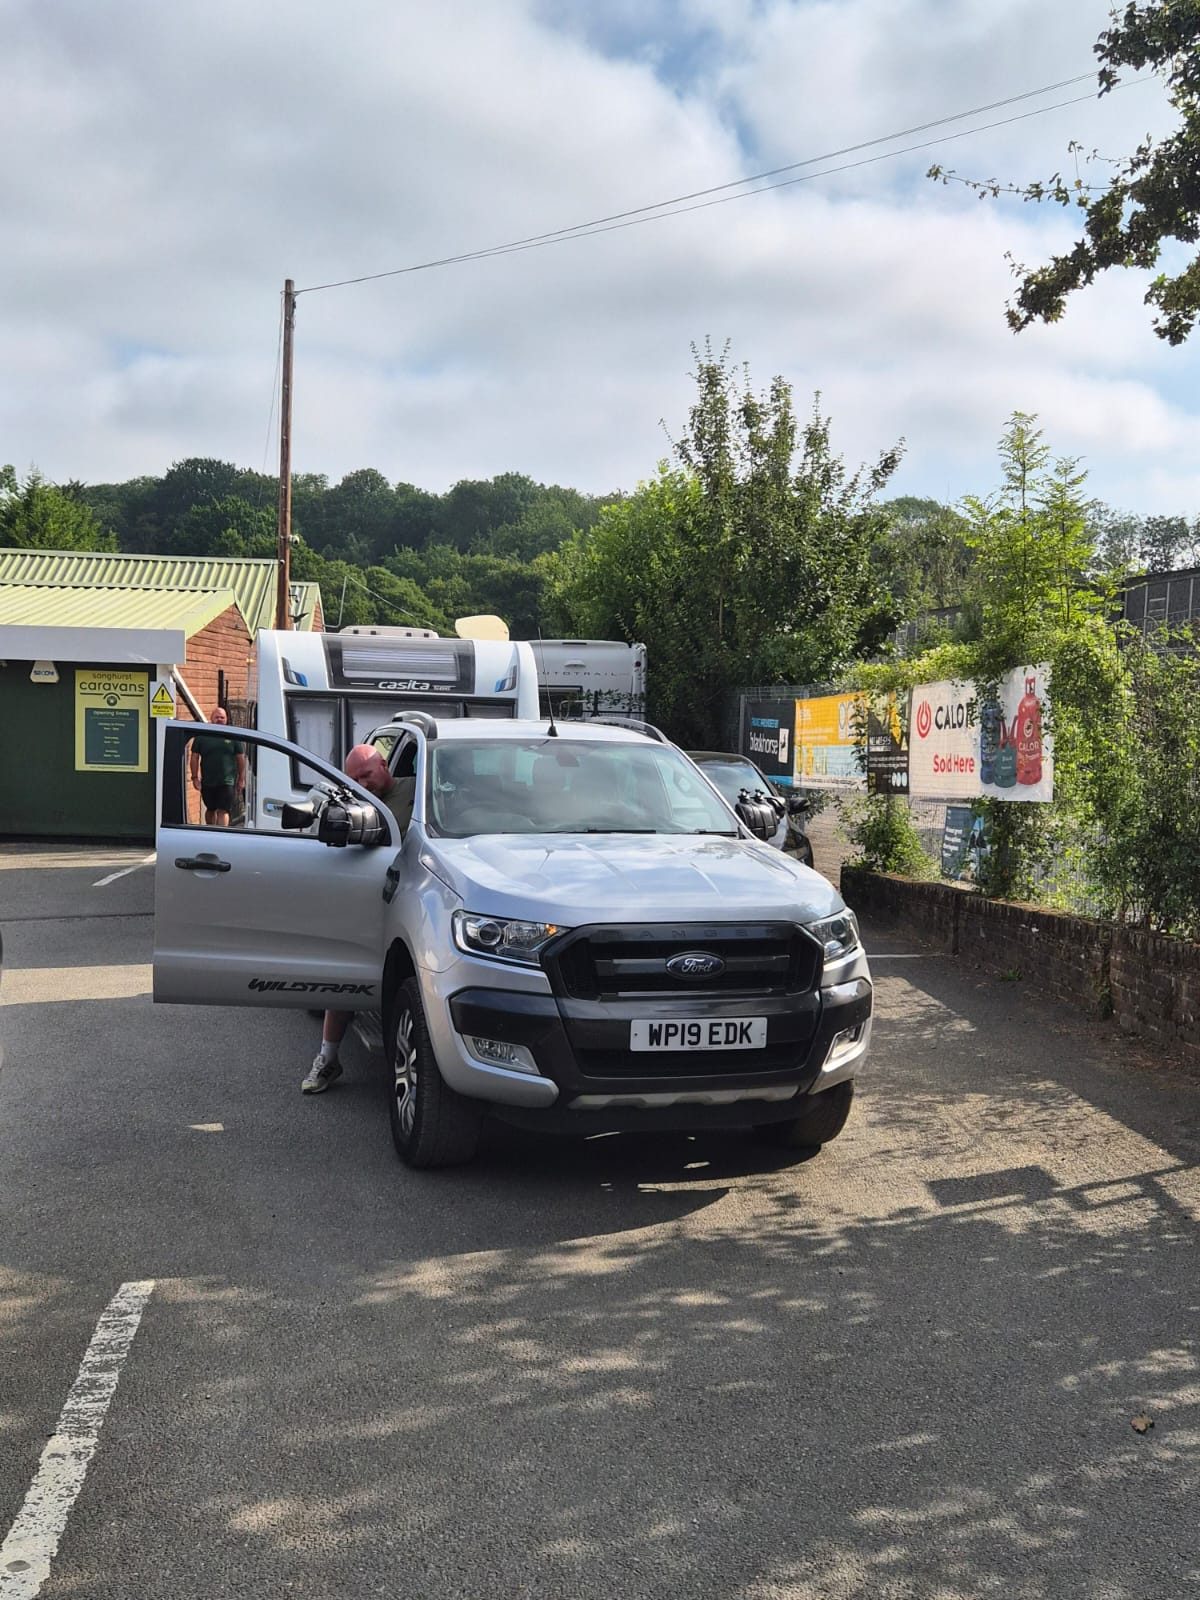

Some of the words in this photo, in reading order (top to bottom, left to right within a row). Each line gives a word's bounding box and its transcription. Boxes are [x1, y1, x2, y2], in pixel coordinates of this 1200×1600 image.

[79, 681, 145, 693] caravans
[378, 680, 430, 690] casita
[933, 753, 952, 773] Sold
[954, 754, 975, 773] Here
[681, 958, 713, 973] Ford
[248, 978, 377, 996] WILDTRAK
[648, 1023, 701, 1046] WP19
[708, 1022, 753, 1045] EDK
